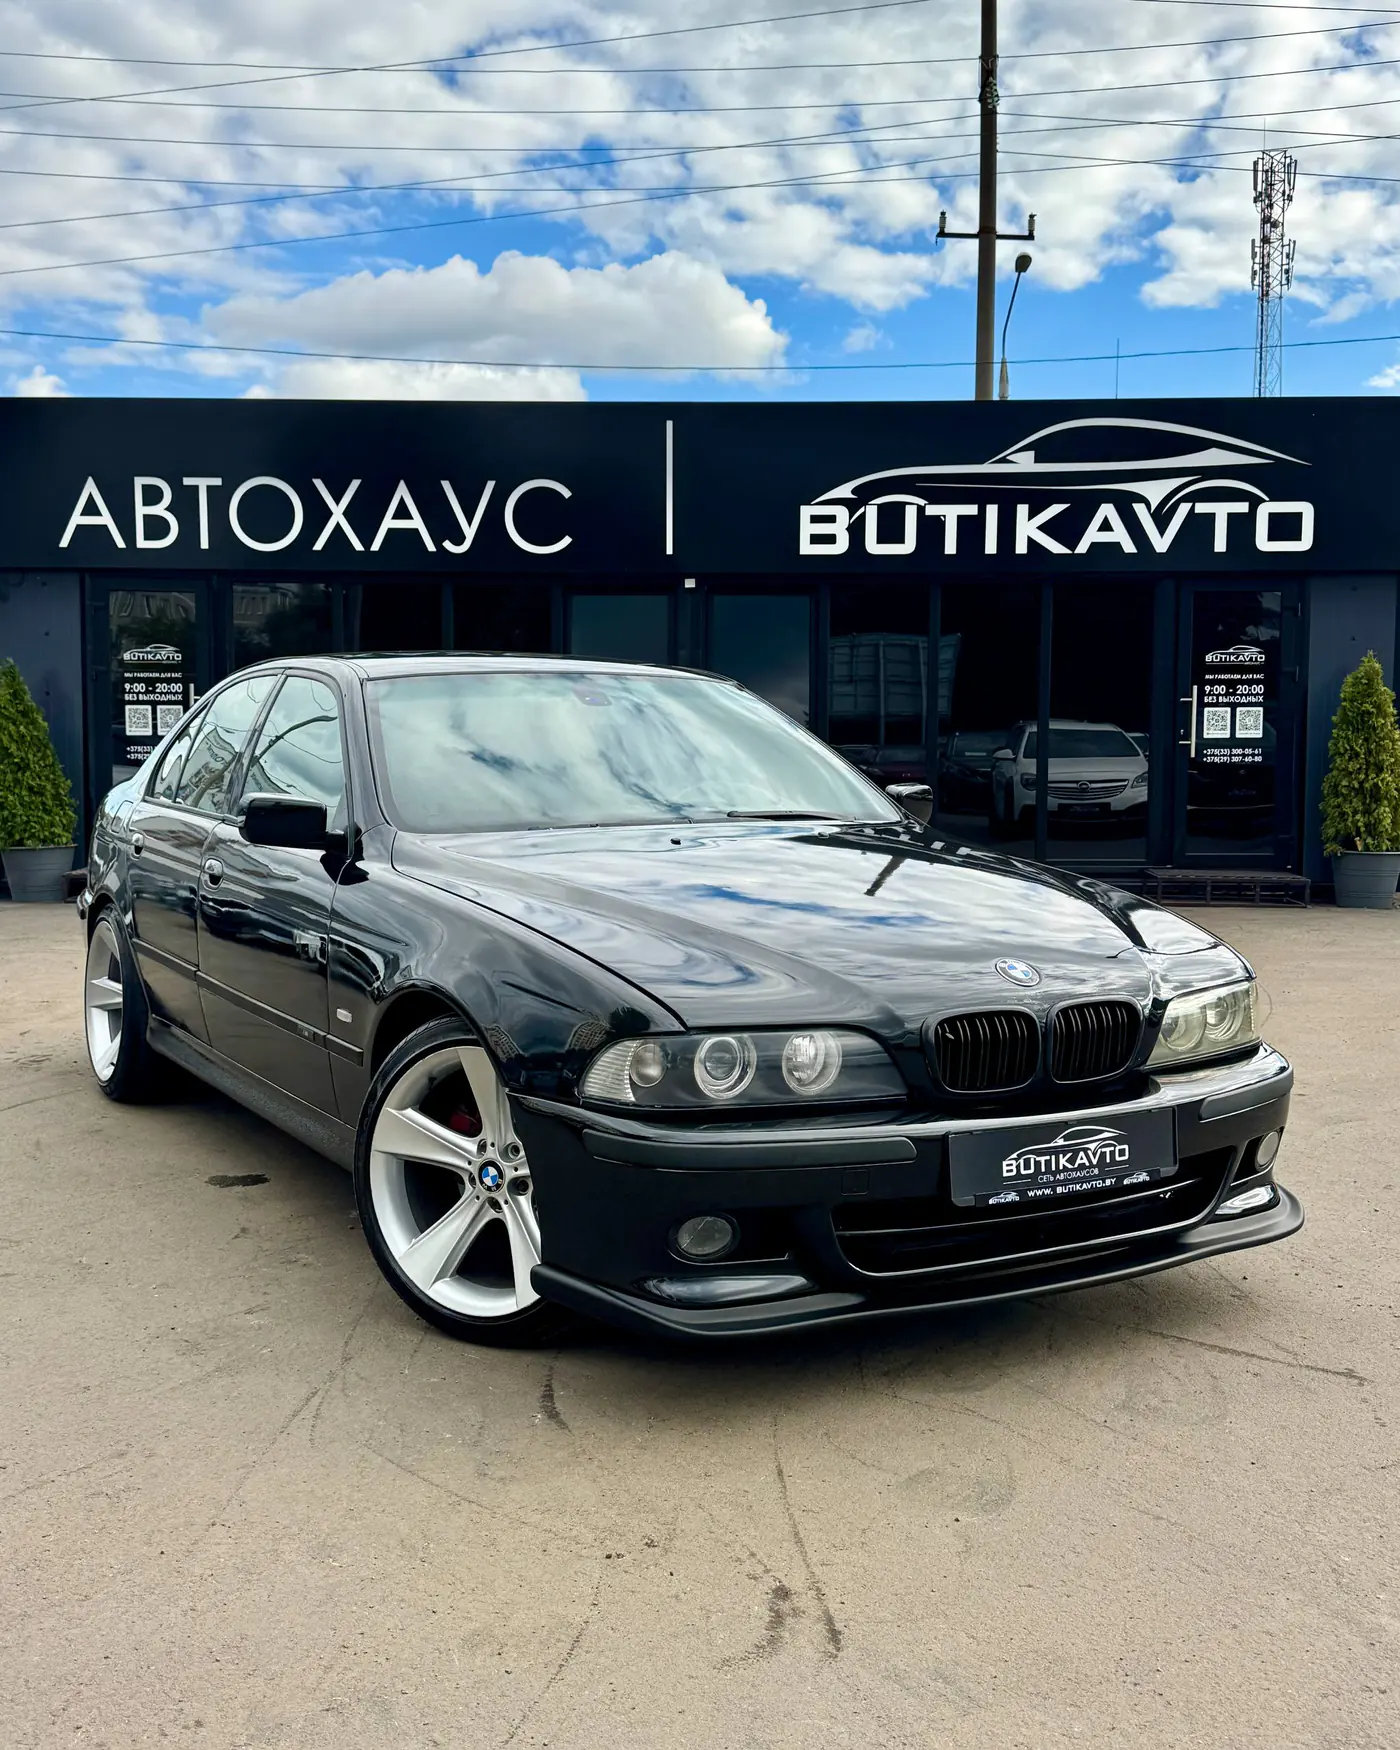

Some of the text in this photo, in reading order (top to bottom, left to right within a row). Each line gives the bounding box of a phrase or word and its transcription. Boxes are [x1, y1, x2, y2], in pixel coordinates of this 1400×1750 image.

[59, 476, 573, 555] АВТОХАУС
[799, 501, 1315, 555] BUTIKAVTO
[123, 653, 182, 661] BUTIKAVTO
[124, 683, 146, 693] 9:00
[155, 683, 183, 693] 20:00
[1204, 685, 1226, 695] 9:00
[1236, 685, 1264, 695] 20:00
[1203, 748, 1230, 756] +375(33)
[1002, 1144, 1129, 1177] BUTIKAVTO
[1038, 1167, 1099, 1183] СЕТЬ АВТОХАУСОВ
[1027, 1178, 1117, 1197] WWW. BUTIKAVTO.BY
